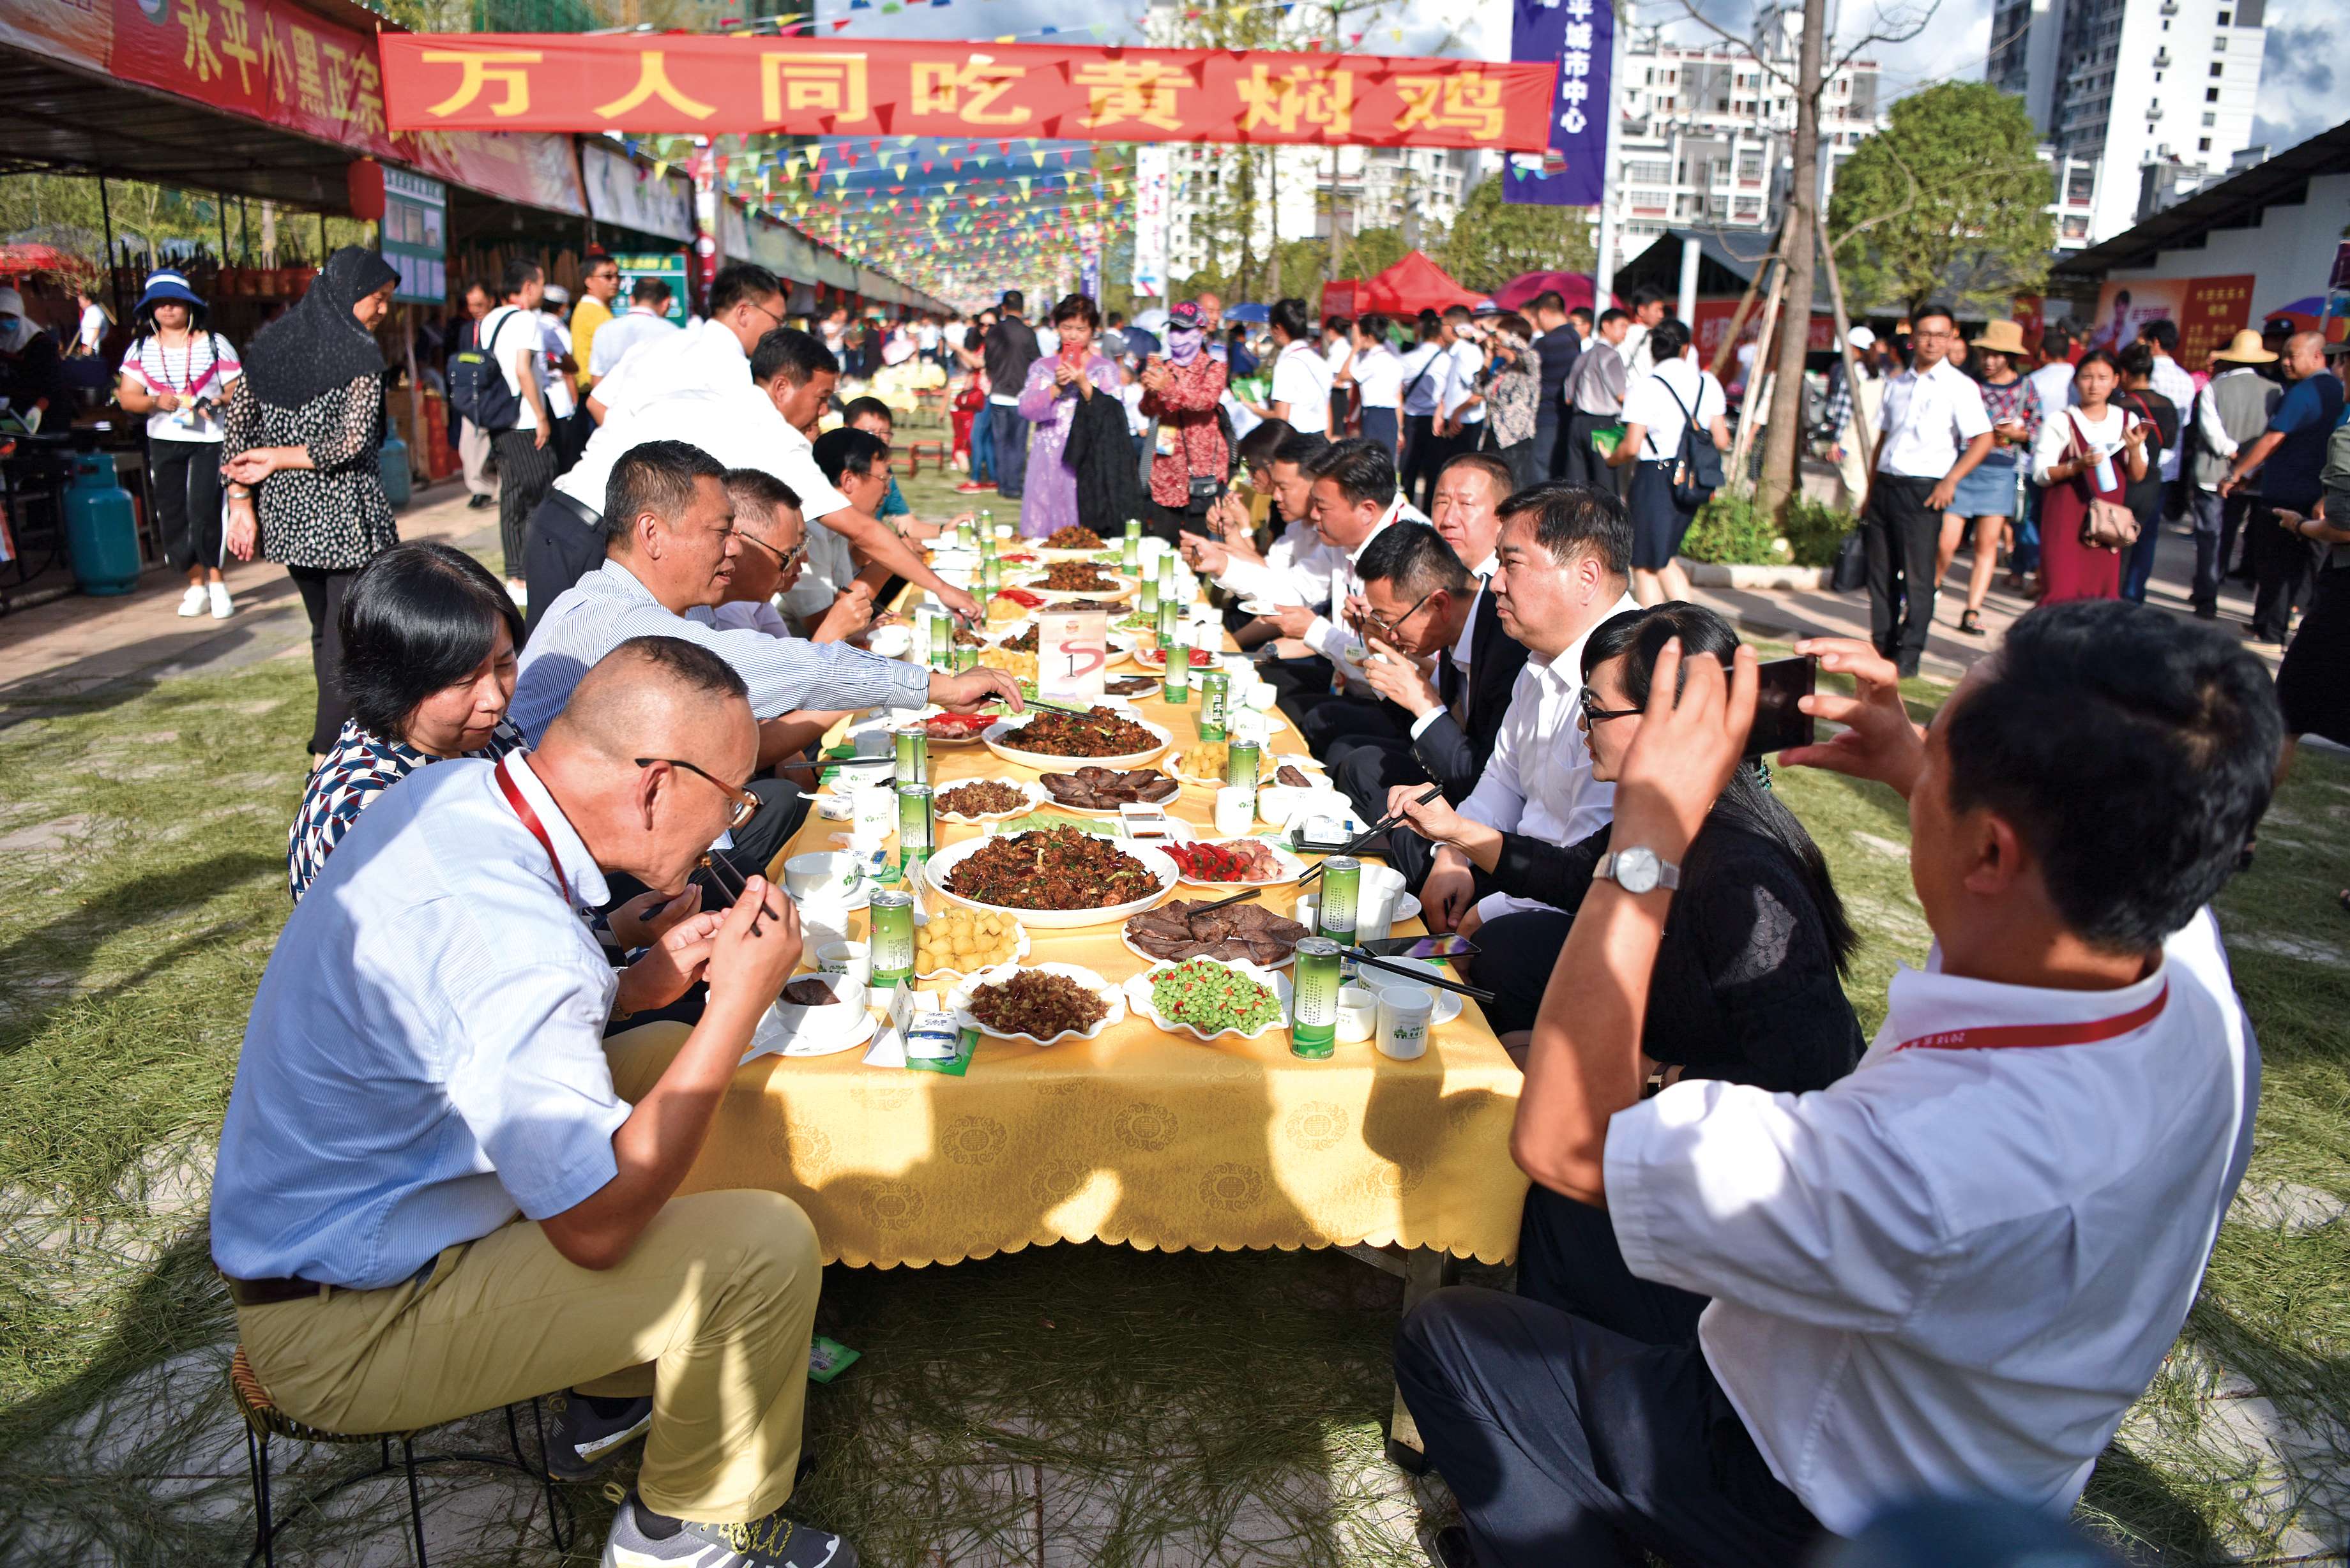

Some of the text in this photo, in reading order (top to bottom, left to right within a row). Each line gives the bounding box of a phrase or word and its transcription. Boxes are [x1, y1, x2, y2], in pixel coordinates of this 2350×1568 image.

[421, 50, 1505, 140] 万人同吃黄焖鸡
